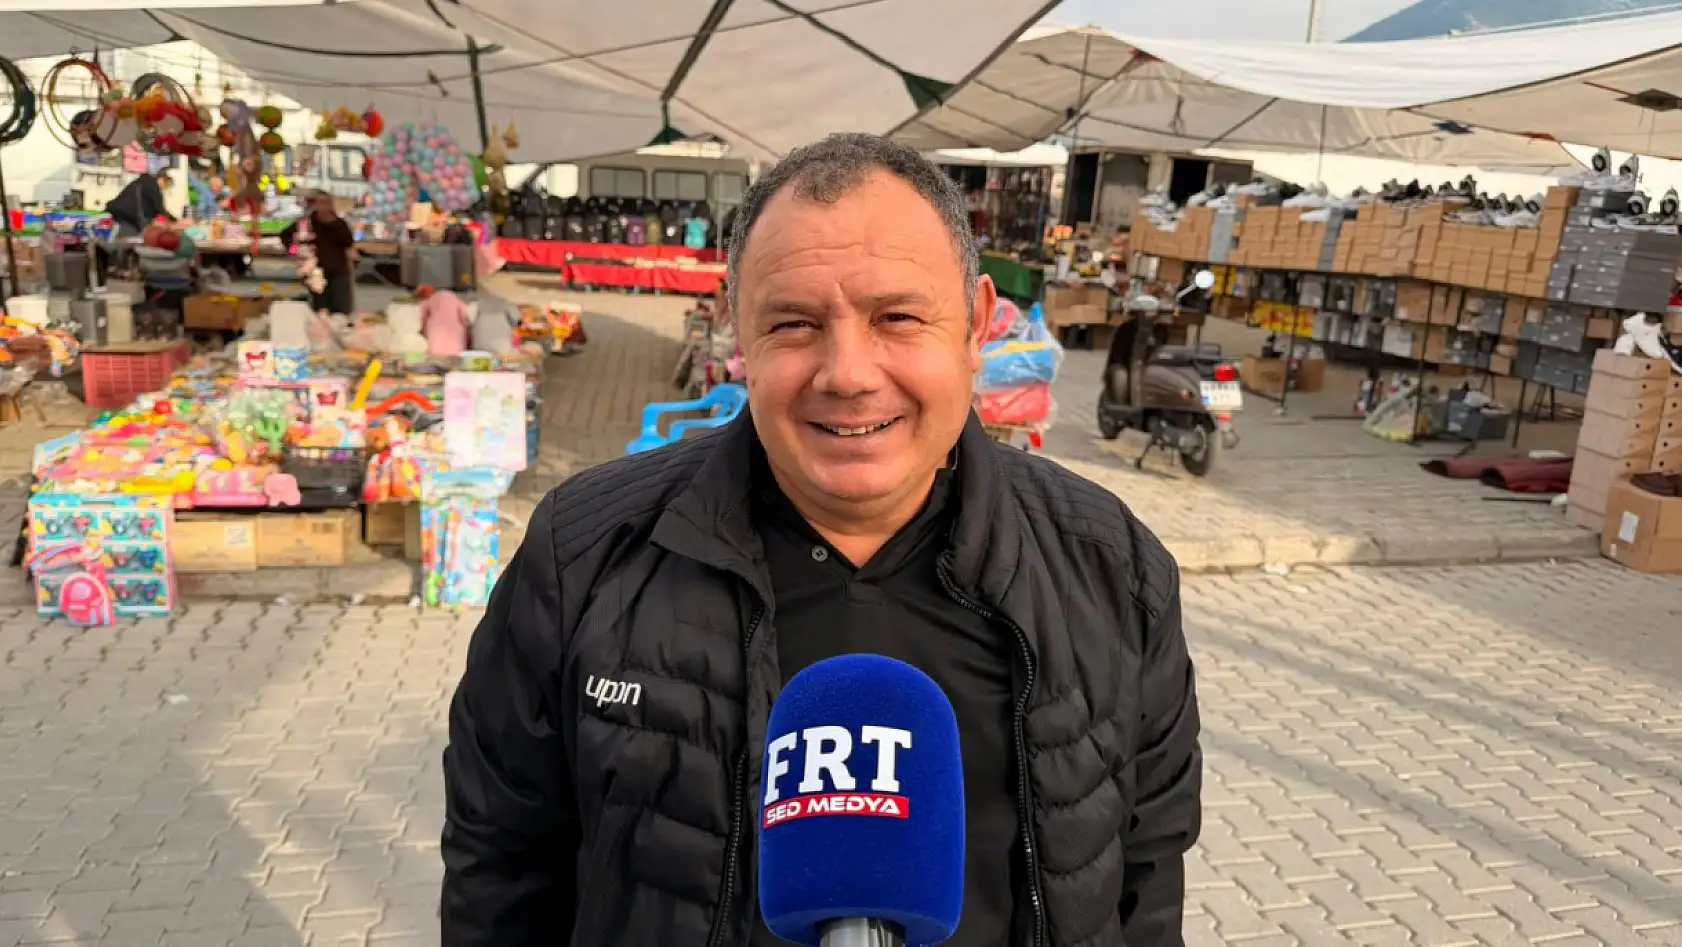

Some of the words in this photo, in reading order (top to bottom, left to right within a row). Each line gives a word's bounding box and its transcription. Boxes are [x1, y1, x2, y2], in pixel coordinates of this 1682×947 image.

[764, 725, 913, 805] FRT
[766, 801, 802, 824] SED
[807, 796, 901, 814] MEDYA
